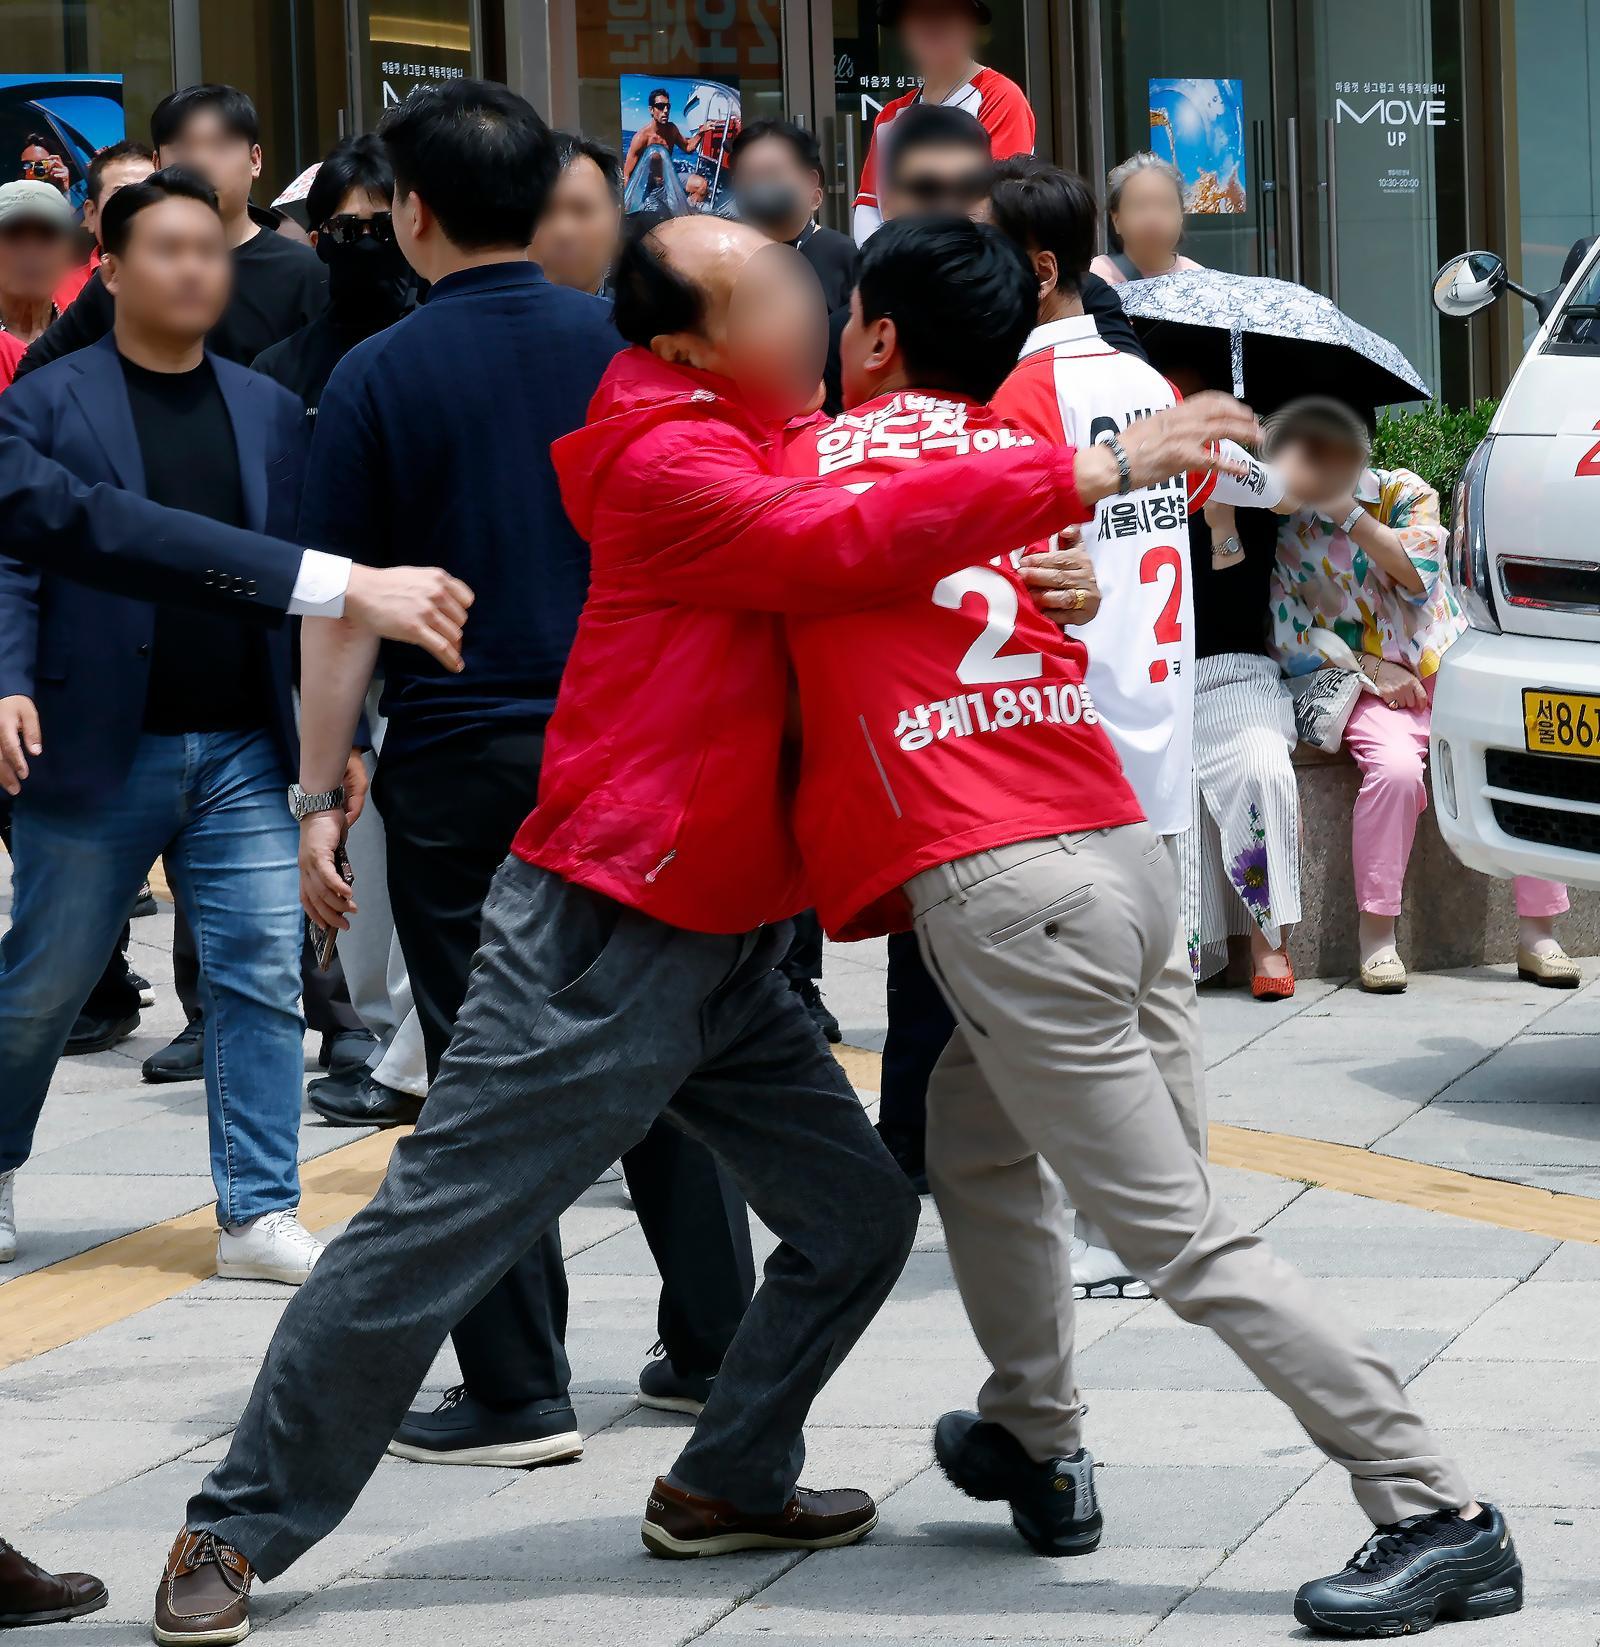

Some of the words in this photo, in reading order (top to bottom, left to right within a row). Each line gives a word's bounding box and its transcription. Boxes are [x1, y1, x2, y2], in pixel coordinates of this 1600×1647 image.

[860, 76, 890, 88] 마음껏
[1335, 81, 1359, 93] 마음껏
[1336, 98, 1446, 126] MOVE
[1387, 131, 1407, 147] UP
[816, 412, 970, 477] 압도적
[931, 565, 1043, 686] 2
